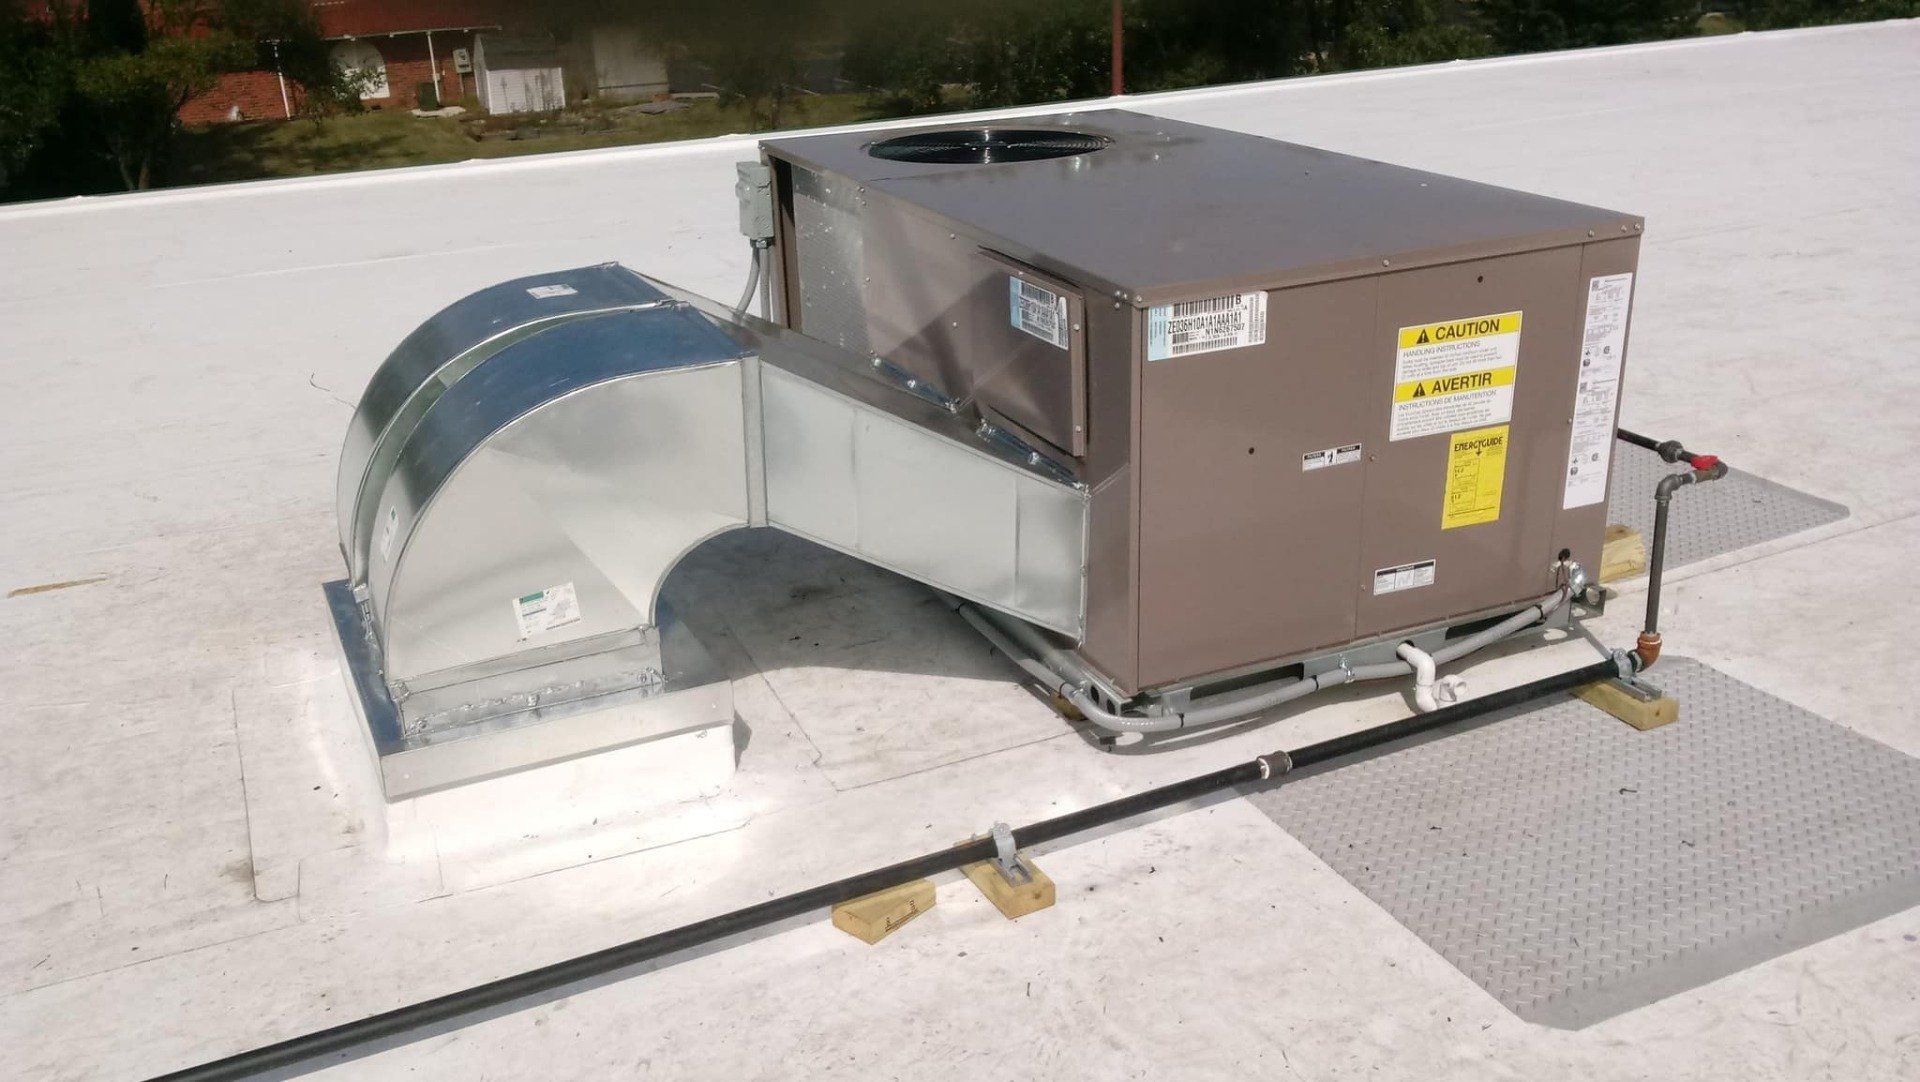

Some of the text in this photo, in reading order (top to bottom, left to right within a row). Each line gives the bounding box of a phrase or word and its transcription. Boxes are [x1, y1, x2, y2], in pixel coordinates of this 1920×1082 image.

[1435, 318, 1500, 340] CAUTION
[1403, 340, 1481, 358] HANDLING INSTRUCTIONS
[1431, 372, 1492, 394] AVERTIR
[1398, 398, 1443, 411] INSTRUCTIONS
[1453, 389, 1497, 402] MANUTENTION
